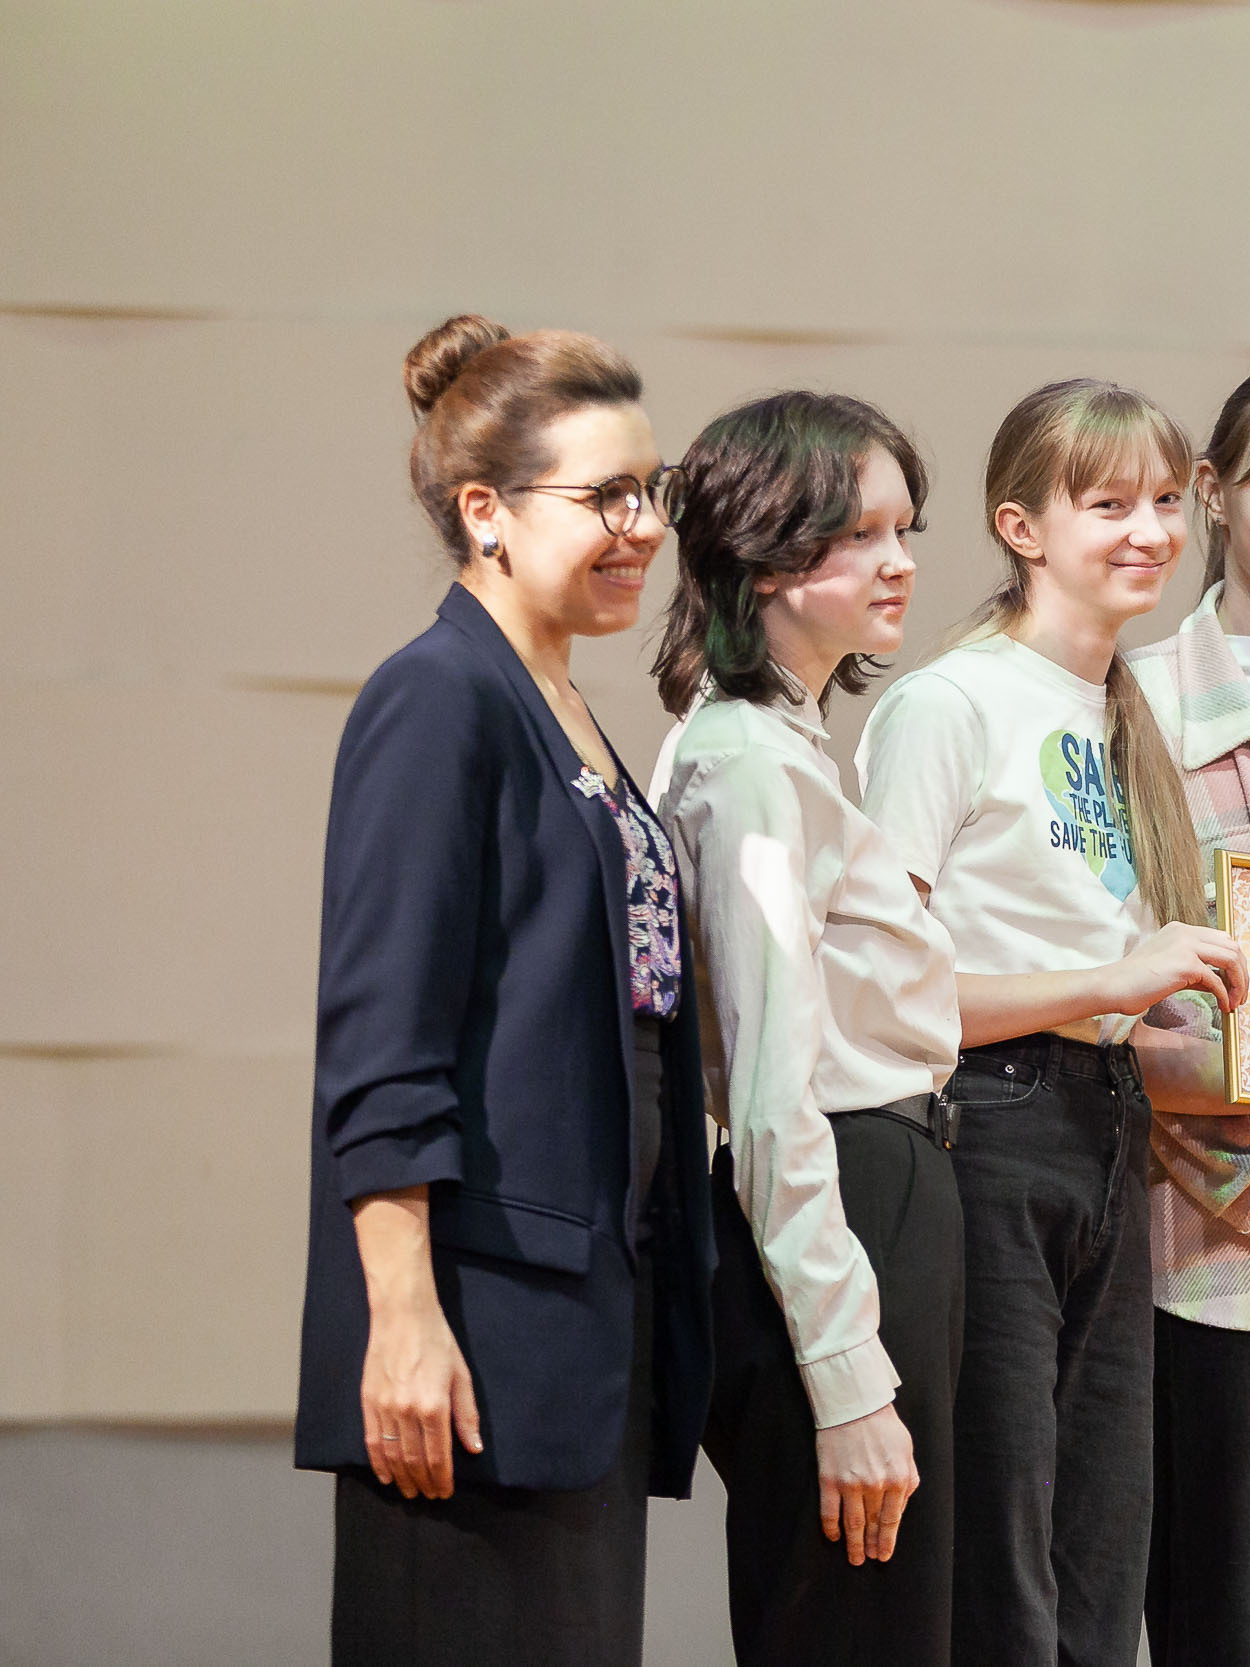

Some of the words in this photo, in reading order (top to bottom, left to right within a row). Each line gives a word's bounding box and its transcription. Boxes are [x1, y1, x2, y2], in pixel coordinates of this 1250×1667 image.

[1069, 793, 1091, 824] THE
[1050, 820, 1087, 854] SAVE
[1090, 829, 1117, 859] THE
